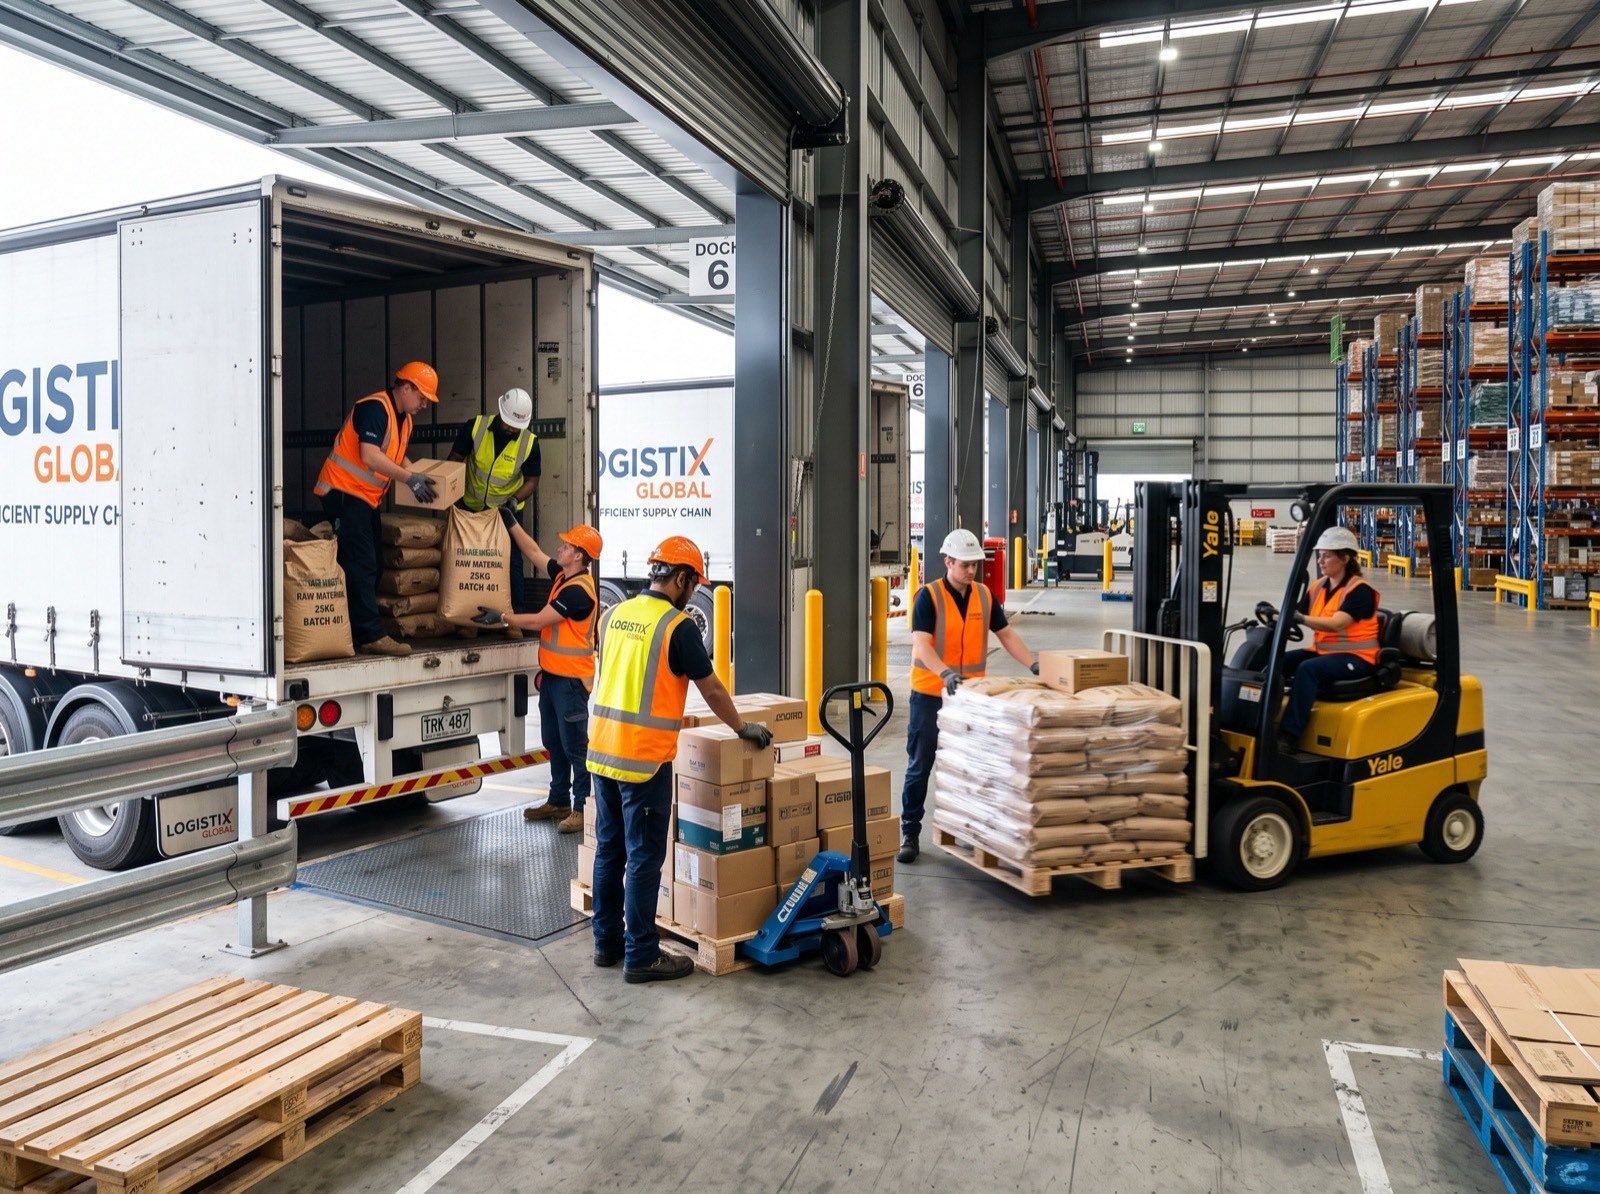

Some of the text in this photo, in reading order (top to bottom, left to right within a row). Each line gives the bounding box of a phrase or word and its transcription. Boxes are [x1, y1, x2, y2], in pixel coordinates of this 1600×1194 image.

[708, 260, 729, 290] 6
[913, 383, 923, 396] 6
[34, 443, 119, 483] GLOB
[636, 481, 711, 499] GLOBAL
[45, 505, 98, 525] SUPPLY
[599, 507, 712, 518] FFICIENT SUPPLY CHAIN
[1203, 510, 1219, 558] Yale
[455, 560, 504, 569] RAW MATERIAL
[459, 583, 499, 592] BATCH 401
[297, 592, 314, 601] RAW
[304, 617, 330, 626] BATCH
[610, 619, 652, 635] LOGISTIX
[424, 717, 444, 734] TRK
[448, 713, 469, 729] 487
[1367, 754, 1403, 776] Yale
[167, 808, 234, 838] LOGISTIX
[202, 825, 235, 839] GLOBAL
